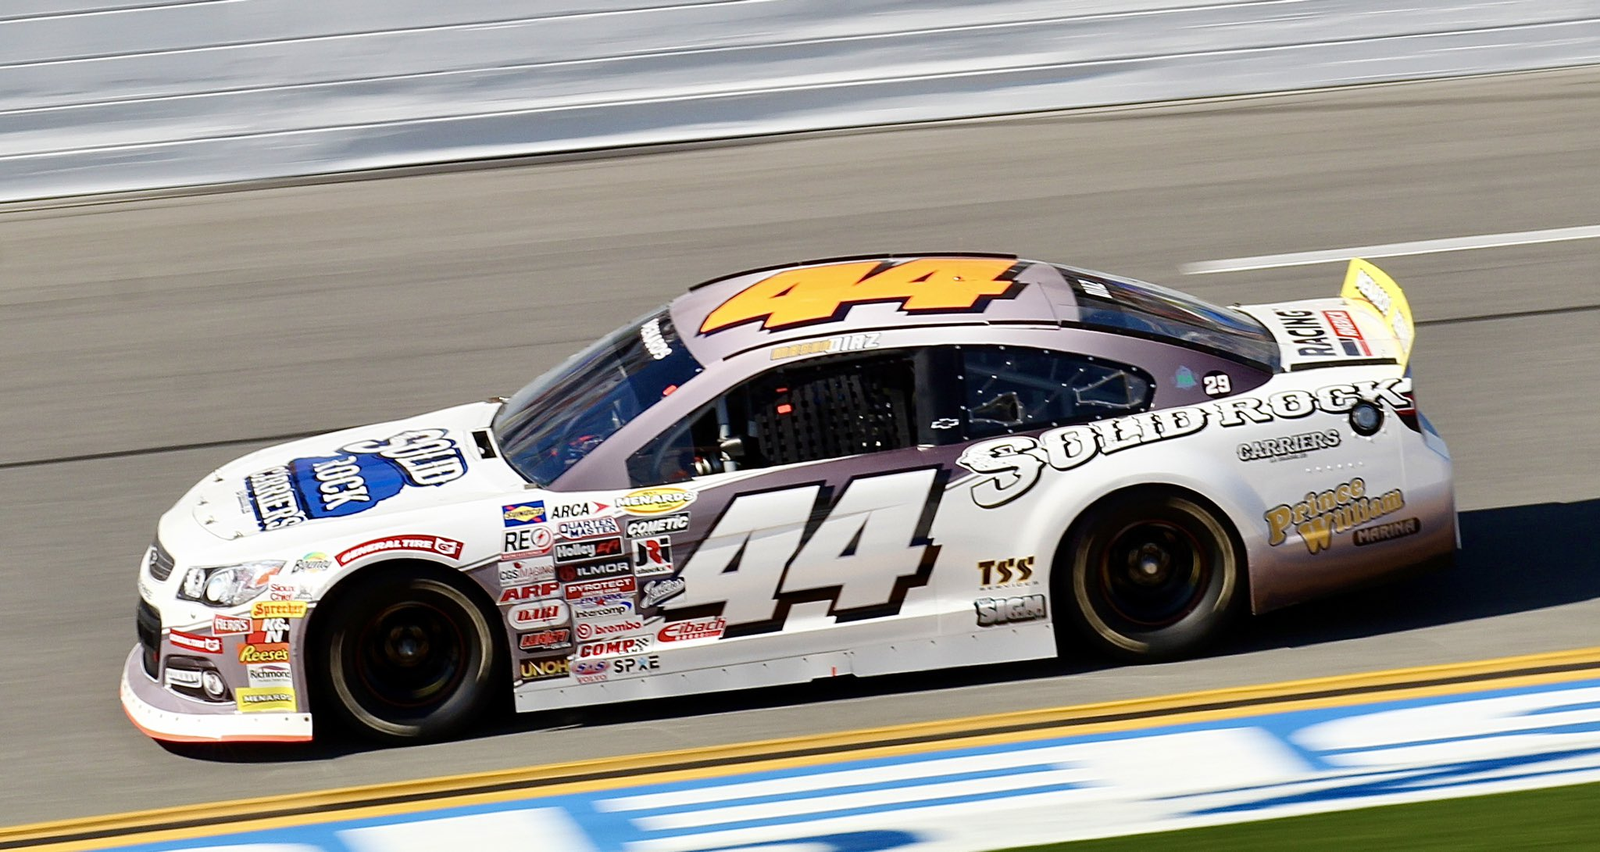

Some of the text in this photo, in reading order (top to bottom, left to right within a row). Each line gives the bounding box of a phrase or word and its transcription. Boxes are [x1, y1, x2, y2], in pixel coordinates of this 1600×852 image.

[698, 257, 1026, 332] 44
[826, 332, 882, 354] DIAZ
[1278, 309, 1337, 356] RACING
[1203, 374, 1231, 395] 29
[955, 378, 1415, 508] SOLID ROCK
[1237, 429, 1341, 461] CARRIERS
[338, 428, 467, 487] SOLID
[313, 456, 371, 511] ROCK
[551, 502, 590, 519] ARCA
[615, 490, 696, 508] MENARDS
[1264, 477, 1365, 546] Prince
[1297, 488, 1405, 555] William
[1358, 519, 1416, 544] MARINA
[340, 539, 433, 563] GENERAL TIRE
[557, 543, 595, 558] Holley
[655, 464, 948, 639] 44
[577, 562, 629, 576] ILMOR
[500, 581, 560, 602] ARP
[568, 579, 632, 593] PYROTECT
[594, 621, 641, 634] brembo
[658, 617, 725, 642] Eibach
[580, 639, 635, 658] COMP
[521, 660, 570, 677] UNOH
